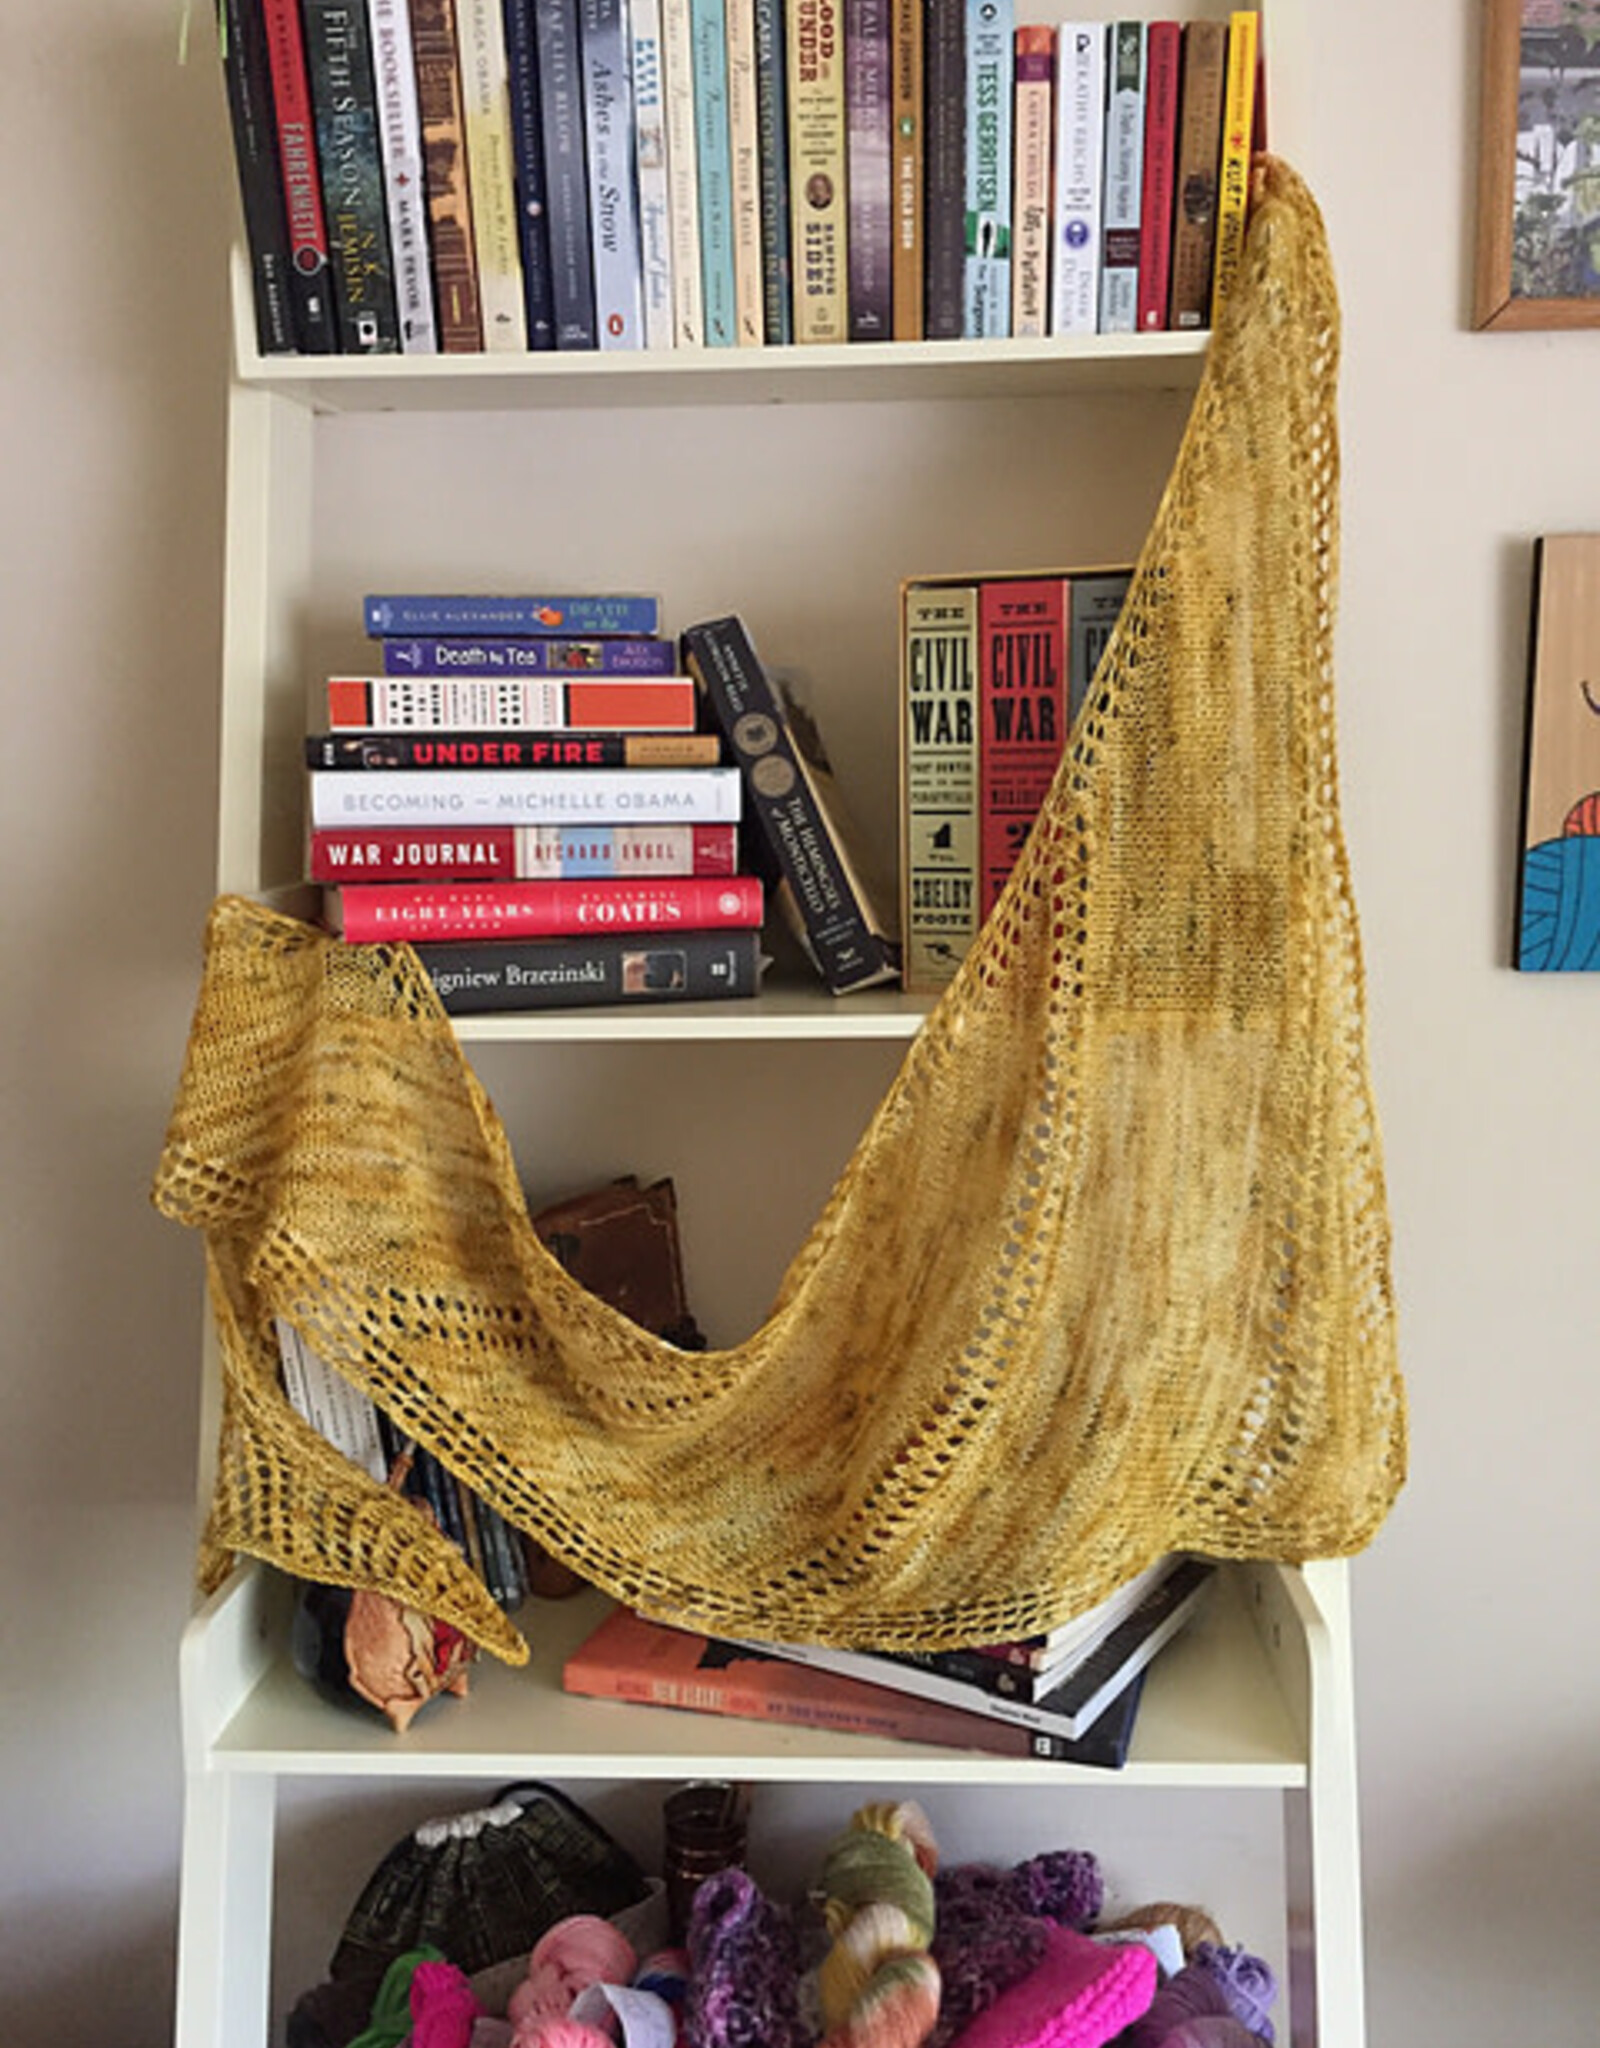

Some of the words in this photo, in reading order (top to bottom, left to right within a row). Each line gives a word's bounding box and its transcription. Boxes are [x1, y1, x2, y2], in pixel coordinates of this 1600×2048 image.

[322, 9, 353, 88] FIFTH
[798, 0, 818, 84] UNDER
[819, 0, 835, 60] OOD
[379, 27, 406, 161] BOOKSELLER
[592, 59, 616, 137] Ashes
[976, 61, 999, 108] TESS
[331, 95, 364, 207] SEASON
[901, 155, 914, 181] THE
[976, 111, 999, 213] GERRITSEN
[281, 122, 319, 240] FAHRENHEIT
[1225, 157, 1243, 208] KURT
[399, 199, 416, 250] MARK
[598, 183, 622, 253] Snow
[805, 223, 824, 297] SIDES
[915, 606, 966, 620] THE
[998, 602, 1049, 617] THE
[435, 644, 488, 666] Death
[506, 646, 538, 666] Tea
[909, 636, 973, 693] CIVIL
[990, 632, 1058, 691] CIVIL
[909, 698, 974, 745] WAR
[990, 695, 1058, 743] WAR
[412, 742, 526, 765] UNDER
[532, 741, 604, 765] FIRE
[342, 793, 465, 813] BECOMING
[496, 793, 607, 811] MICHELLE
[616, 792, 697, 809] OBAMA
[326, 842, 384, 867] WAR
[391, 842, 501, 866] JOURNAL
[536, 844, 613, 861] RICHARD
[621, 844, 677, 861] ENGEL
[576, 901, 683, 923] COATES
[911, 913, 972, 926] FOOTE
[431, 966, 503, 995] igniew
